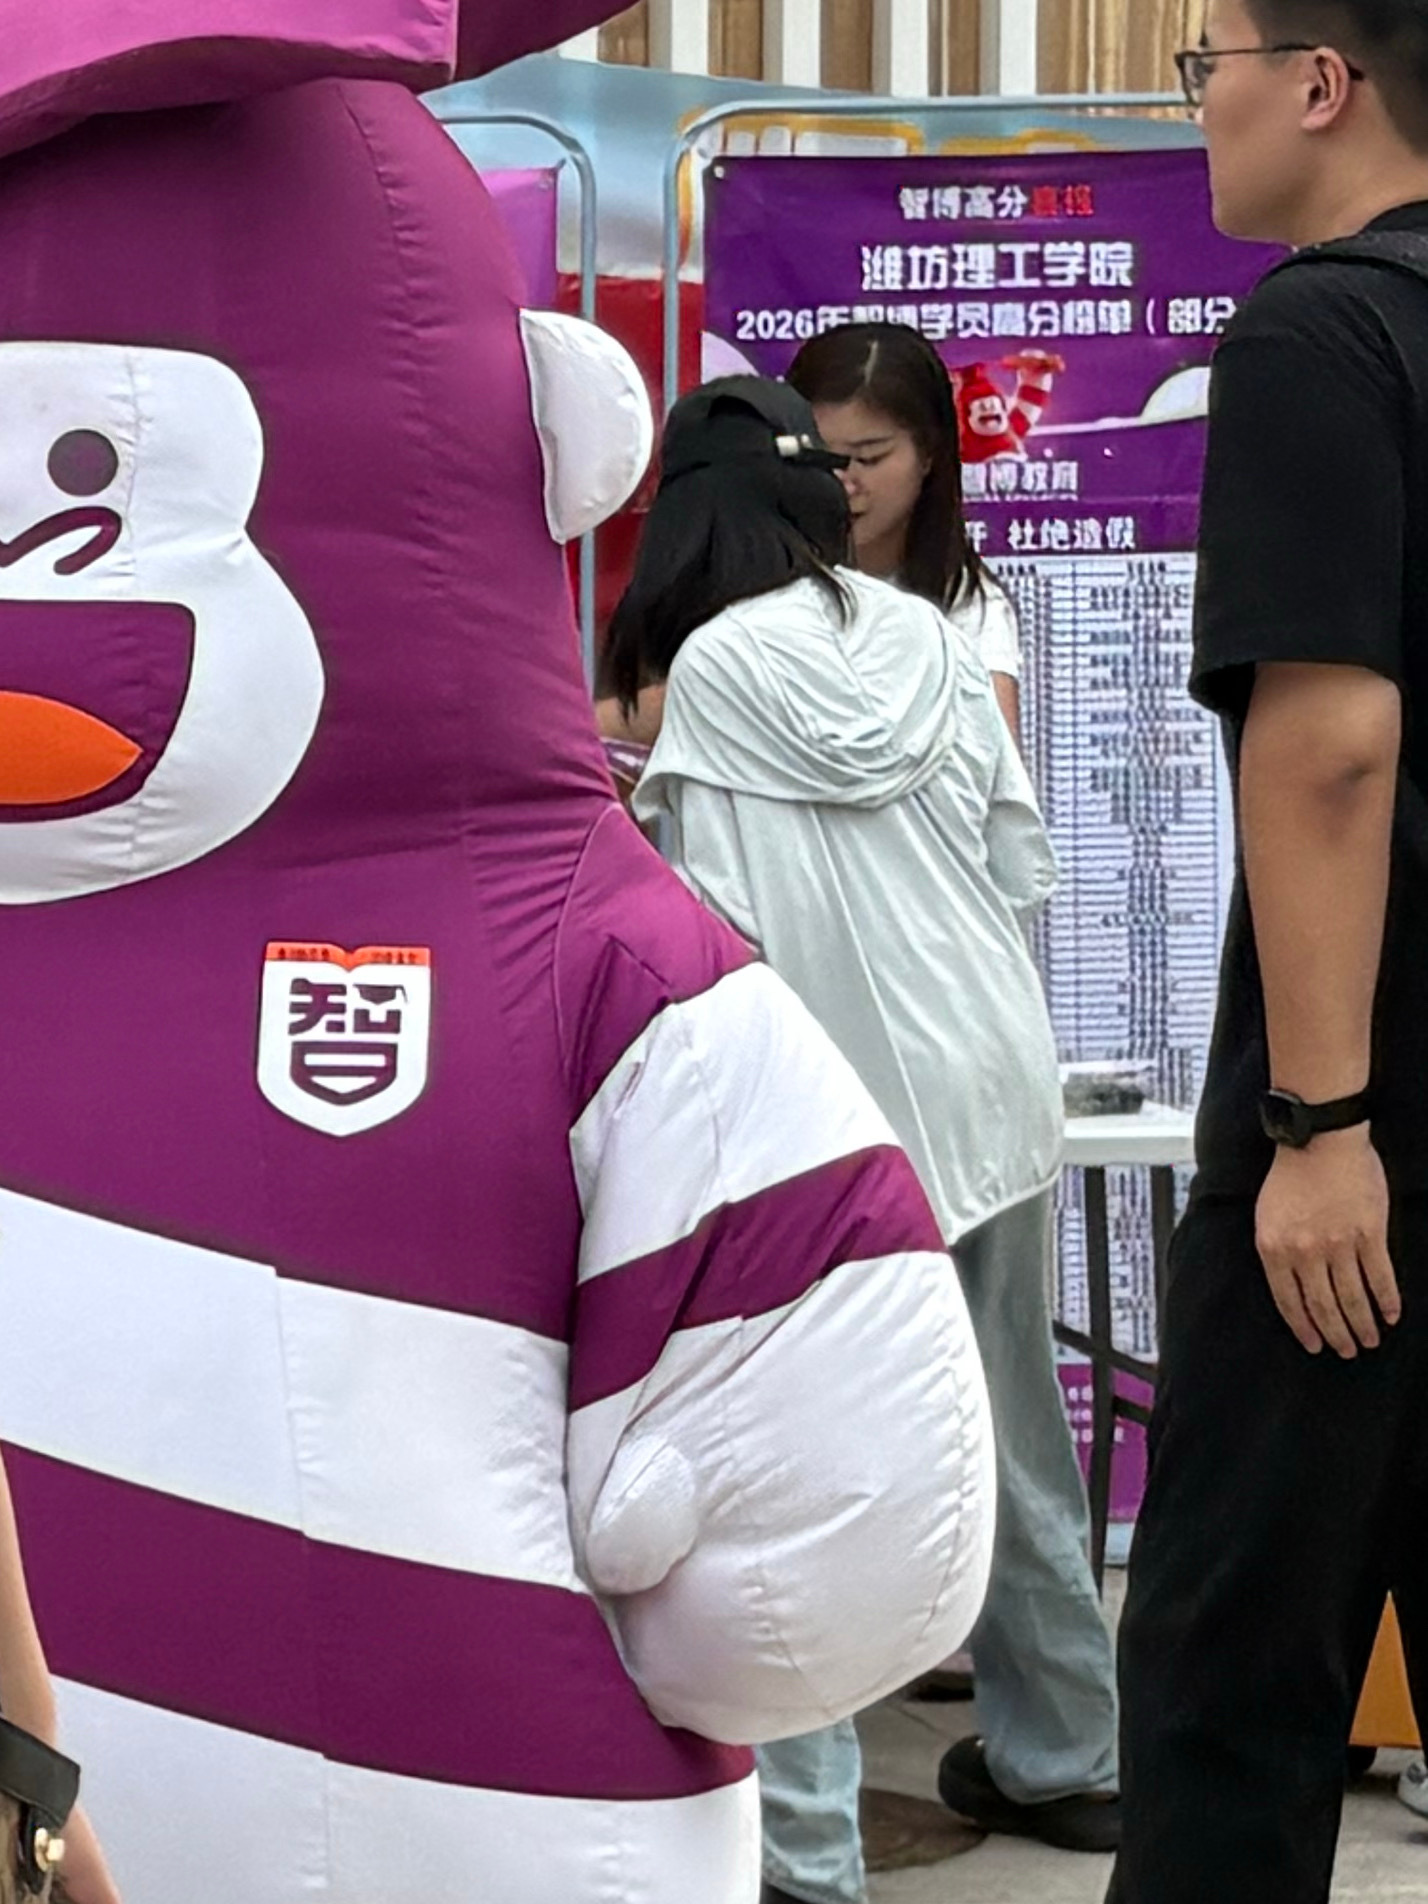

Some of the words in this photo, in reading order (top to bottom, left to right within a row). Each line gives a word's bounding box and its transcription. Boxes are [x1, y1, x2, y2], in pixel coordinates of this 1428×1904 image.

[860, 241, 1135, 292] 潍坊理工学院
